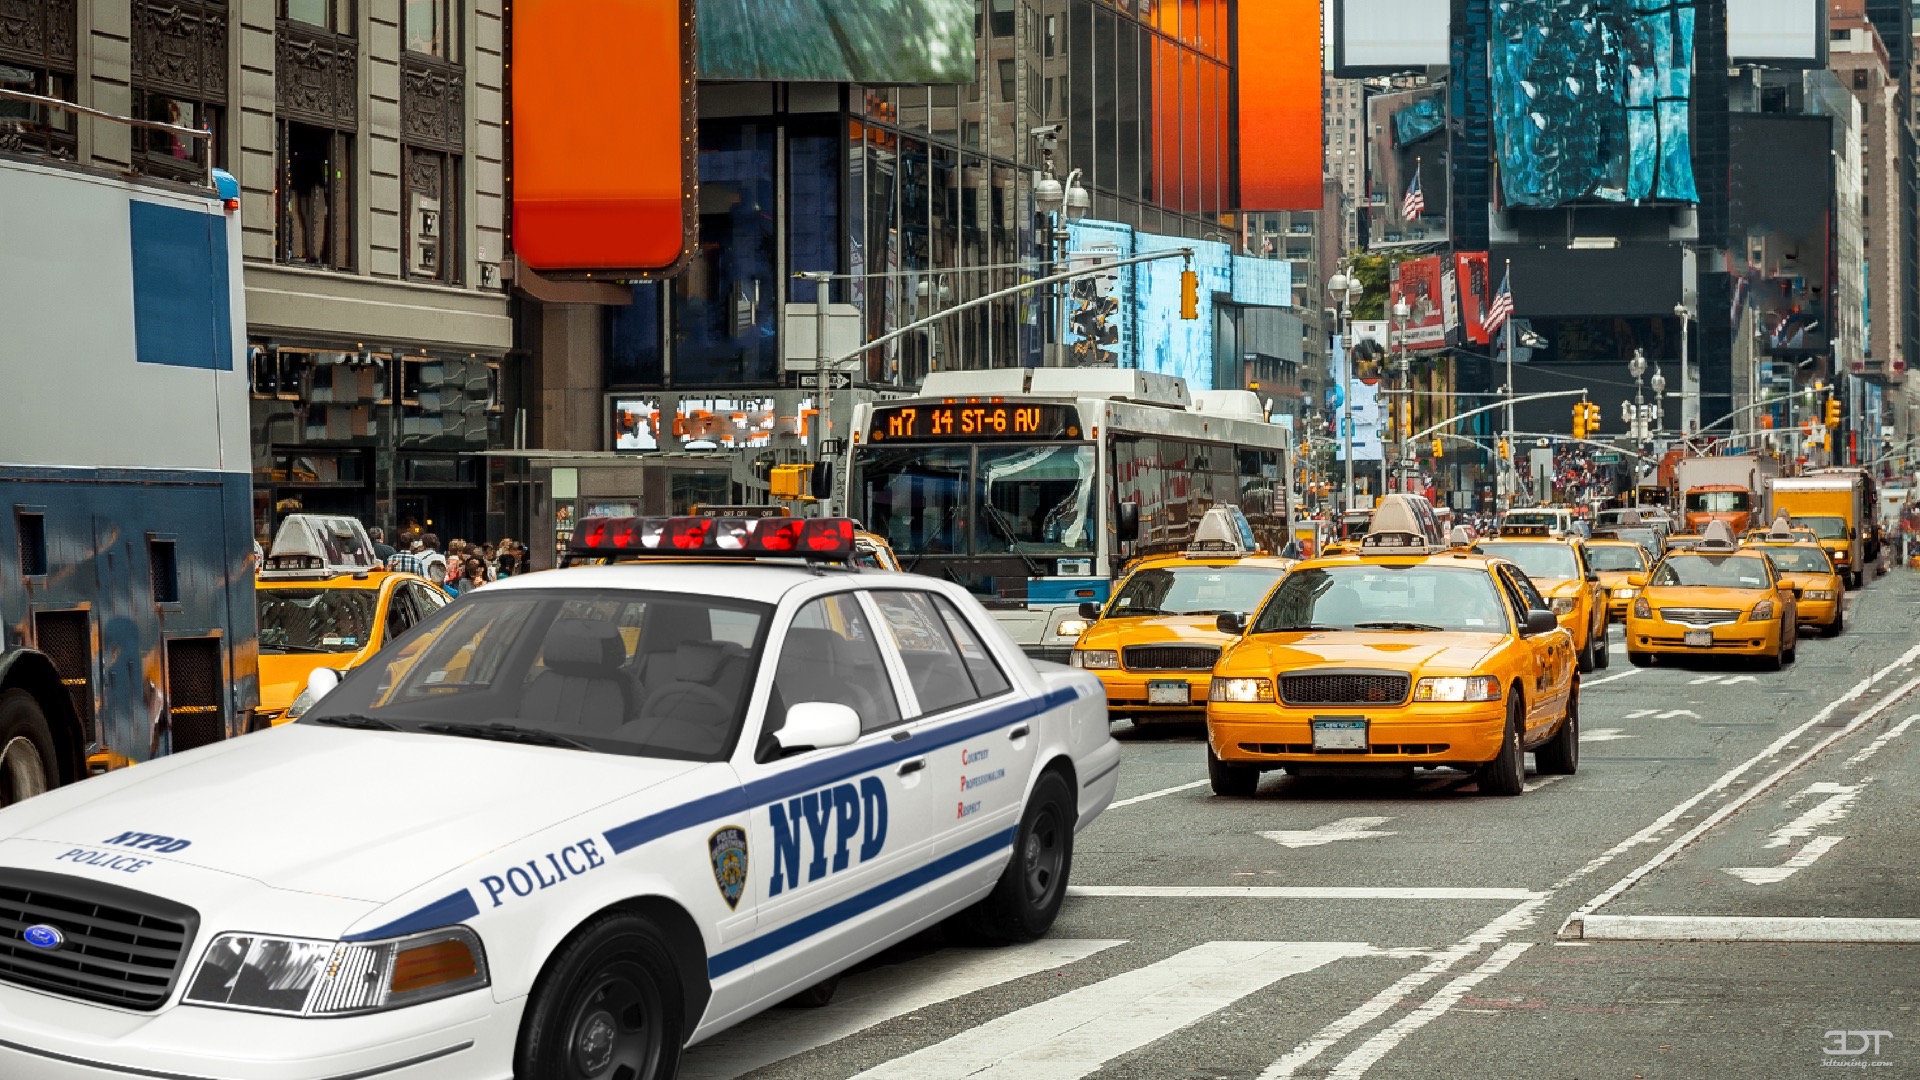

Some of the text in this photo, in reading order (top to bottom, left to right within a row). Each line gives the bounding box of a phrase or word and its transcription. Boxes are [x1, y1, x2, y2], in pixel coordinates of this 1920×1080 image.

[932, 409, 954, 434] 14
[961, 409, 1007, 433] ST-6
[1014, 408, 1041, 432] AV
[101, 830, 193, 854] NYPD
[715, 829, 738, 845] POLICE
[768, 775, 889, 898] NYPD
[55, 848, 154, 873] POLICE
[711, 839, 746, 861] DEPARTMENT
[479, 837, 606, 908] POLICE
